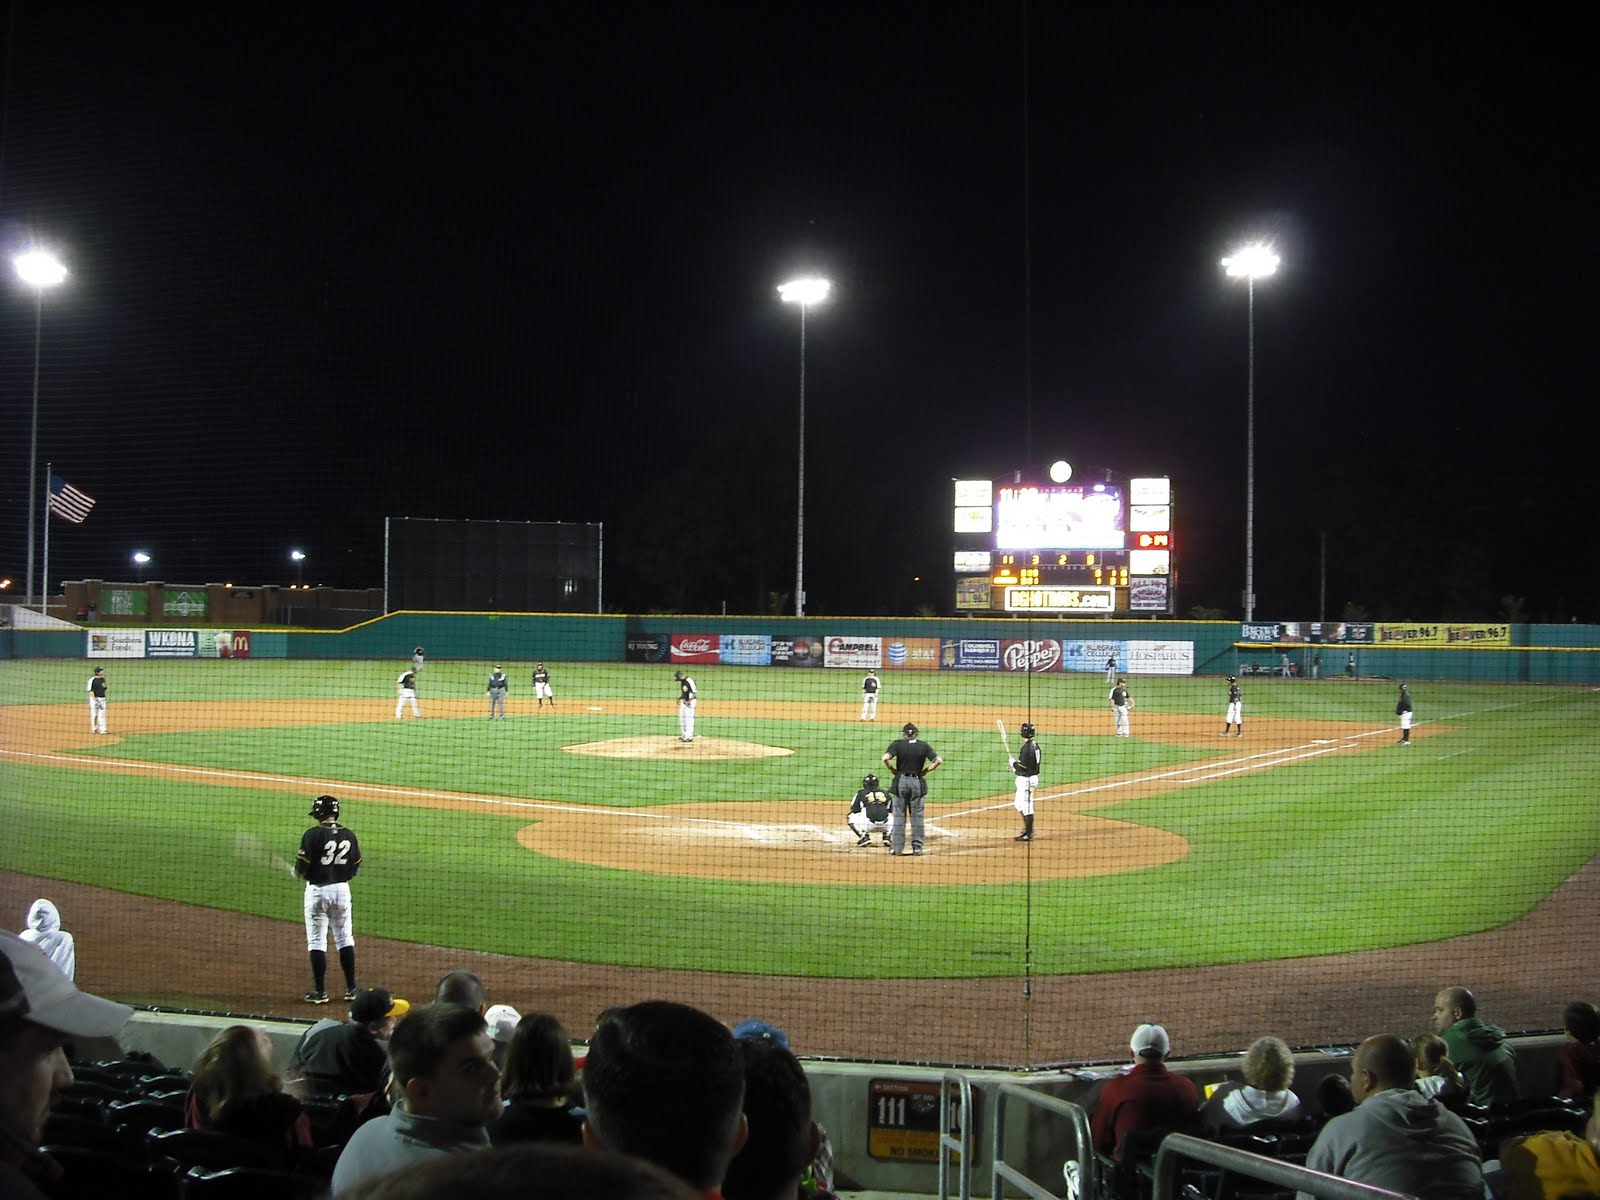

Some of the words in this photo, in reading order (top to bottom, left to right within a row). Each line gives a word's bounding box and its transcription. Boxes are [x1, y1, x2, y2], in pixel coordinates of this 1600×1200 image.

[1420, 627, 1438, 637] 96.7
[1487, 627, 1507, 637] 96.7
[1024, 640, 1043, 657] Dr
[1010, 647, 1057, 672] Pepper
[320, 840, 351, 866] 32
[878, 1096, 906, 1126] 111
[891, 1147, 905, 1156] NO
